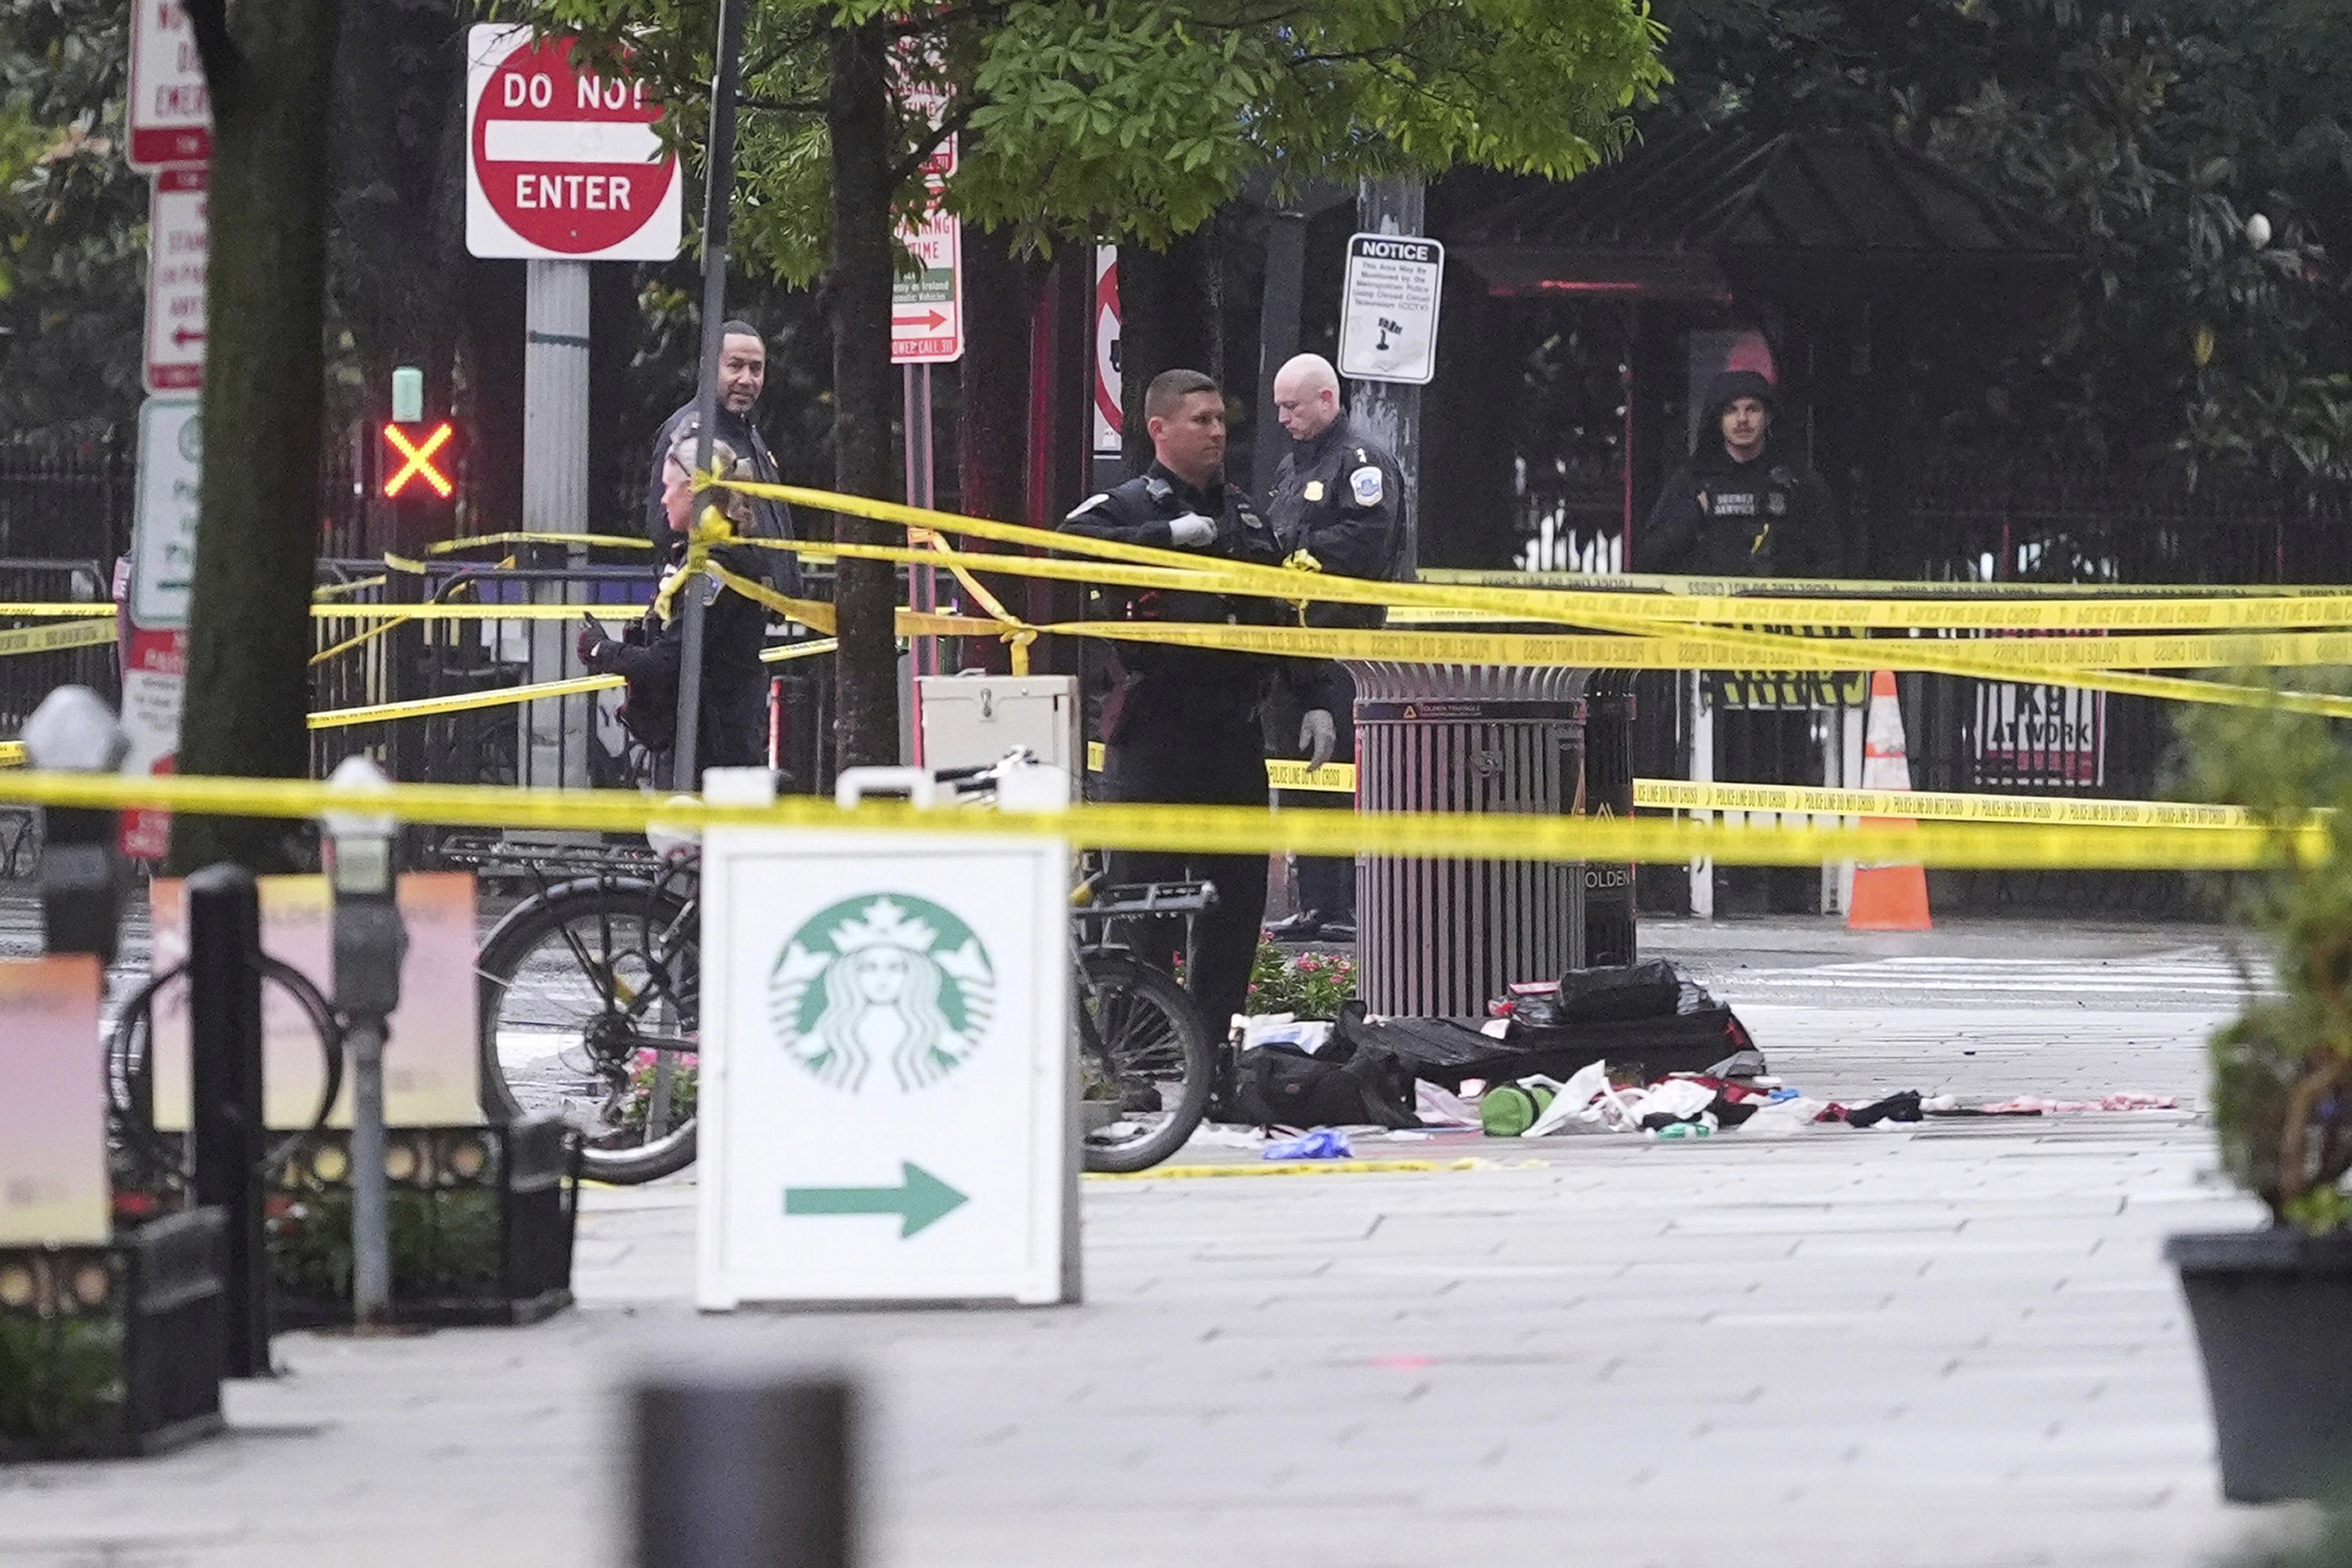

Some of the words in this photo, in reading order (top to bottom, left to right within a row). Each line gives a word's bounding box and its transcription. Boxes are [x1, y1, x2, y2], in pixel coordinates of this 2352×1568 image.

[504, 73, 553, 109] DO
[516, 174, 631, 210] ENTER
[1362, 240, 1429, 261] NOTICE
[1361, 271, 1399, 280] Monitored
[1401, 274, 1410, 282] by
[1399, 265, 1414, 273] May
[921, 280, 949, 290] Ireland
[1356, 280, 1403, 290] Metropolitan
[1406, 283, 1429, 292] Police
[918, 292, 946, 301] Vehicles
[1377, 291, 1404, 299] Closed
[1355, 299, 1395, 308] Television
[1398, 302, 1428, 311] (CCTV)
[918, 340, 938, 354] CALL
[941, 339, 953, 353] 311
[2024, 723, 2089, 744] WORK
[1269, 766, 1288, 784] POLICE
[1289, 767, 1300, 784] LINE
[1322, 768, 1339, 786] CROSS
[1646, 785, 1659, 802] LINE
[1659, 785, 1666, 803] DO
[1668, 786, 1679, 803] NOT
[1680, 787, 1698, 804] CROSS
[1717, 788, 1735, 806] POLICE
[1736, 789, 1748, 806] LINE
[1748, 789, 1756, 806] DO
[1757, 790, 1768, 807] NOT
[1769, 790, 1786, 808] CROSS
[1805, 793, 1823, 810] POLICE
[1824, 793, 1836, 810] LINE
[1836, 794, 1844, 810] DO
[1845, 794, 1856, 811] NOT
[1857, 795, 1875, 811] CROSS
[1893, 796, 1912, 813] POLICE
[1912, 797, 1924, 814] LINE
[1925, 797, 1932, 814] DO
[1933, 797, 1945, 814] NOT
[1946, 798, 1963, 815] CROSS
[1982, 800, 2000, 816] POLICE
[2001, 800, 2013, 817] LINE
[2013, 801, 2021, 817] DO
[2022, 801, 2033, 818] NOT
[2034, 802, 2051, 818] CROSS
[2069, 804, 2088, 820] POLICE
[2089, 804, 2100, 820] LINE
[2101, 804, 2108, 820] DO
[2109, 805, 2120, 821] NOT
[2121, 805, 2139, 821] CROSS
[1585, 871, 1629, 888] OLDEN
